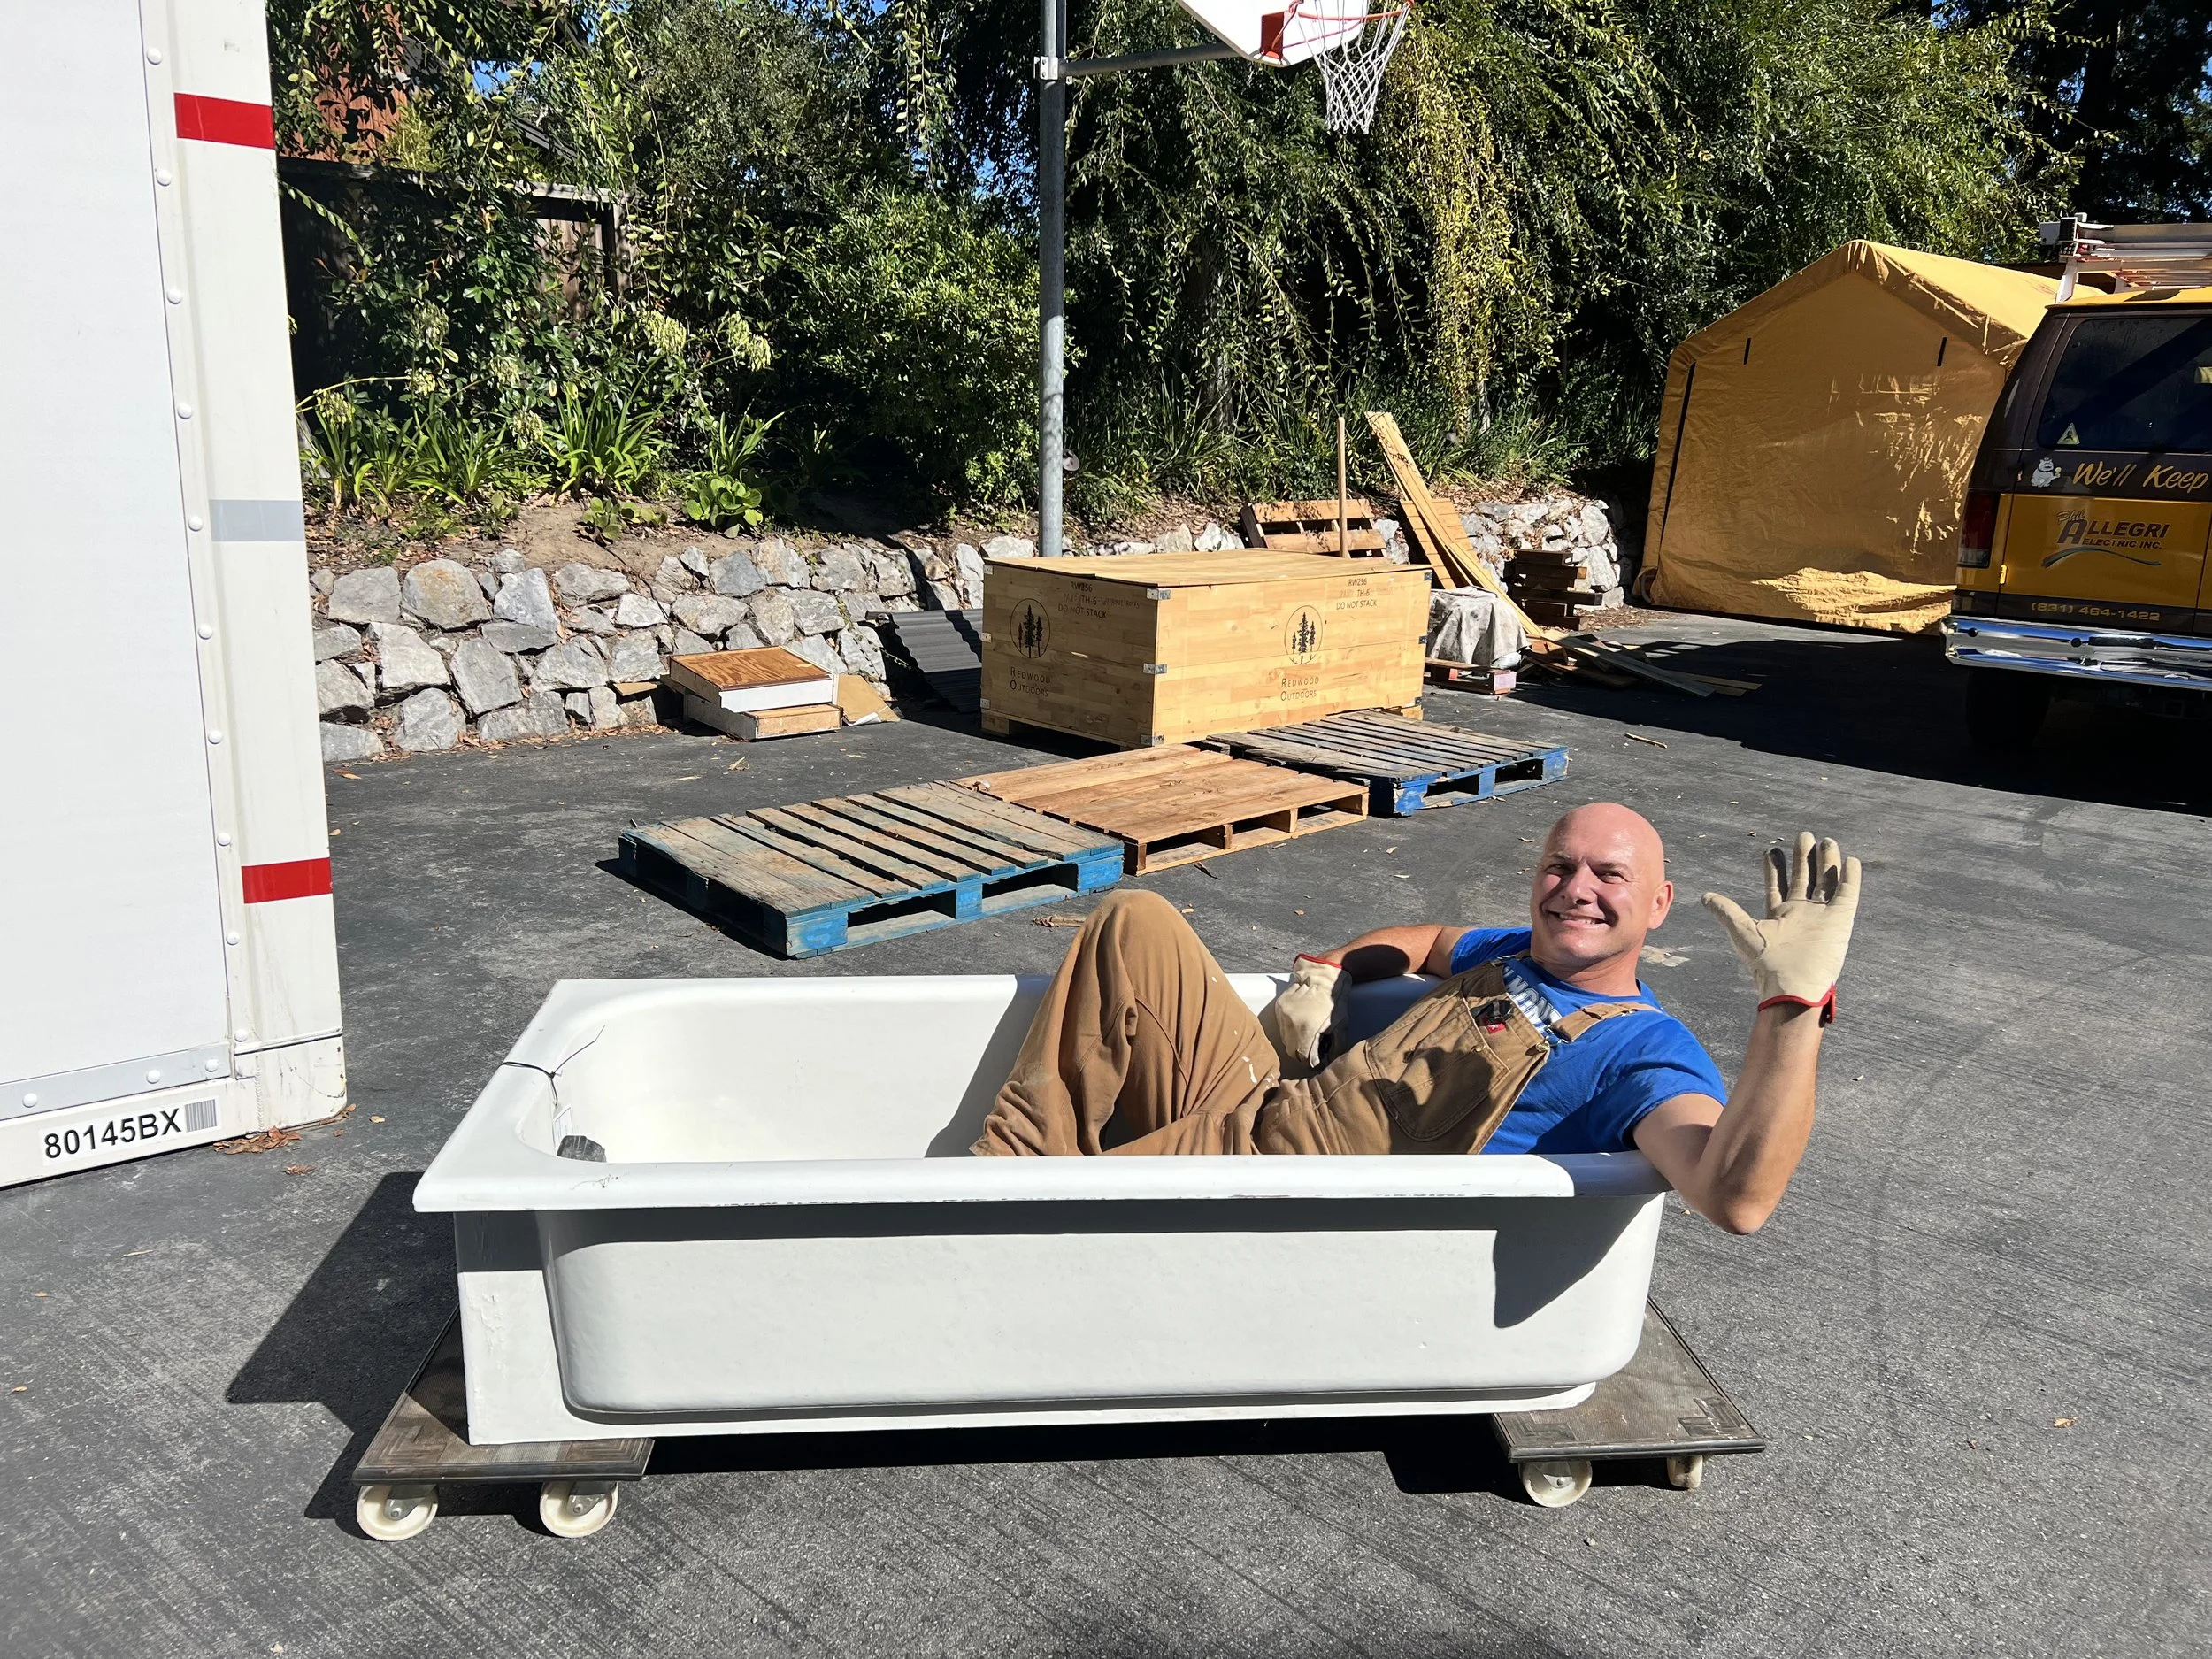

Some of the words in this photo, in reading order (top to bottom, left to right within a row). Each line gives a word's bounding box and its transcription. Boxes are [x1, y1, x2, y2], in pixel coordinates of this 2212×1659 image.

[2072, 461, 2138, 487] We'll
[2142, 465, 2209, 494] Keep
[2057, 509, 2086, 525] Phil
[2057, 518, 2170, 544] ALLEGRI
[2082, 537, 2137, 549] ELECTRIC
[2139, 541, 2162, 550] INC.
[1348, 578, 1368, 587] RW256
[1057, 603, 1068, 612] DO
[1086, 608, 1107, 618] STACK
[1336, 602, 1346, 611] DO
[1360, 599, 1378, 608] STACK
[2031, 602, 2073, 613] (831)
[2078, 605, 2161, 621] 464-1422
[43, 1108, 182, 1159] 80145BX
